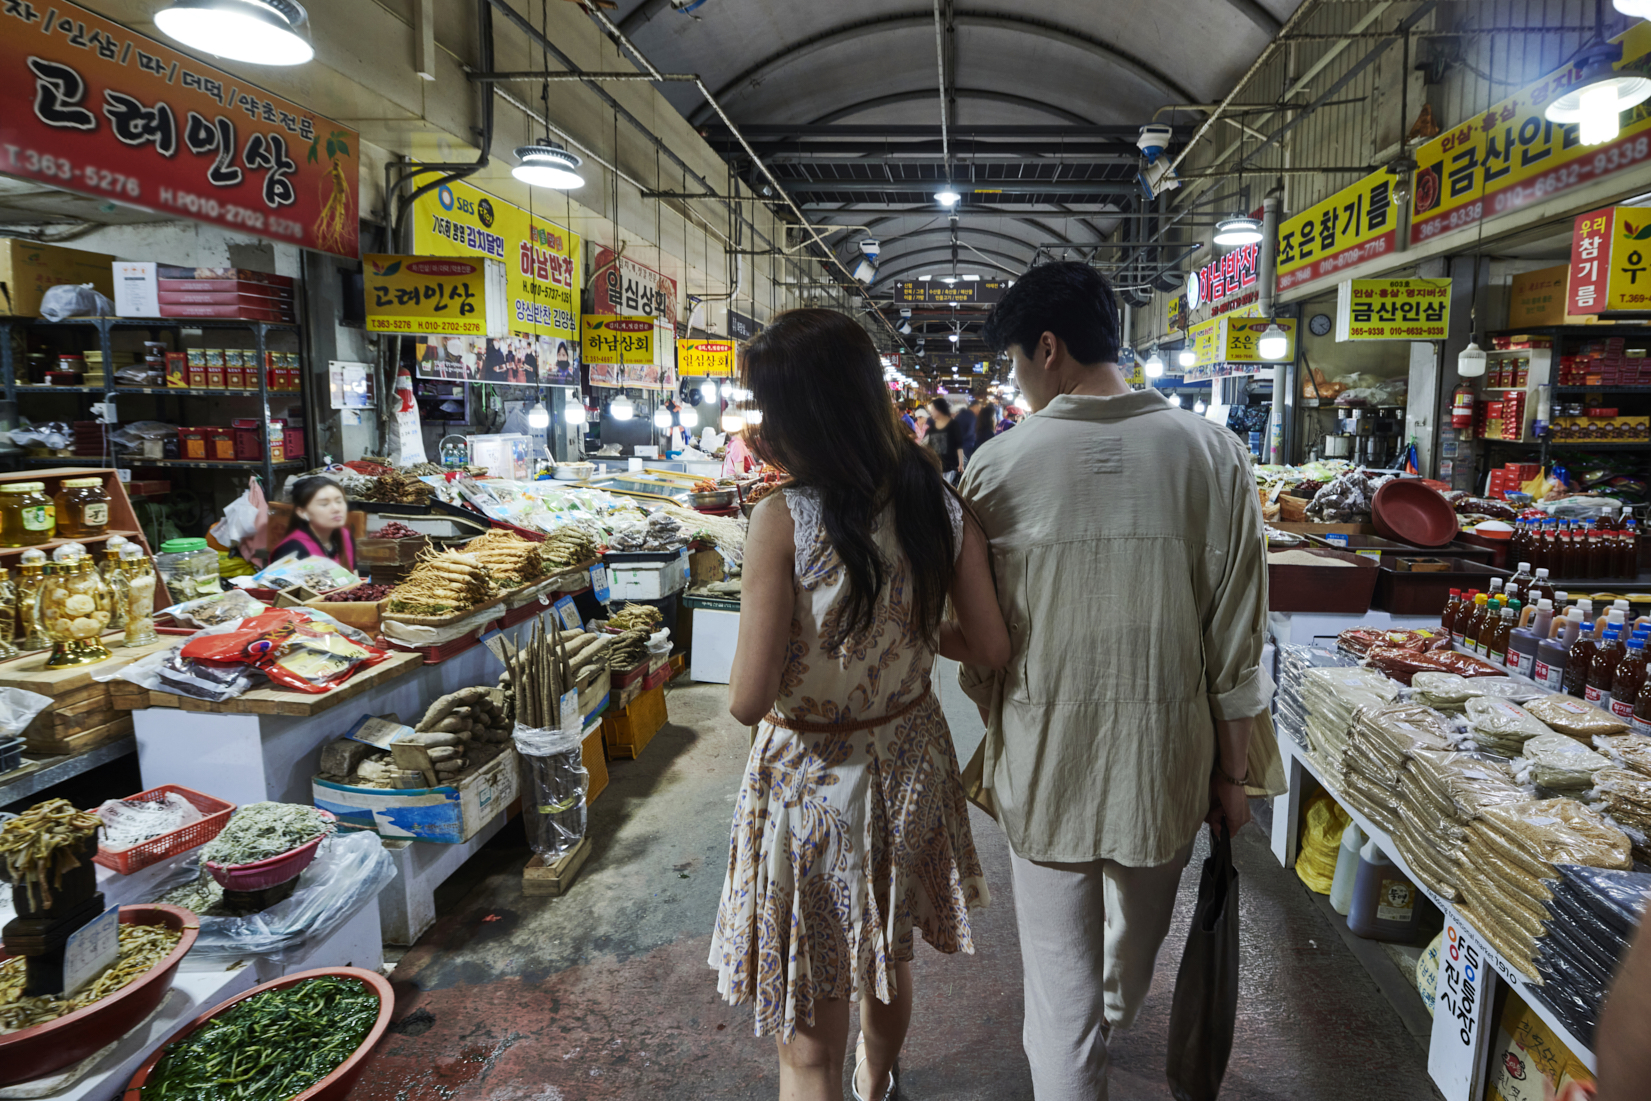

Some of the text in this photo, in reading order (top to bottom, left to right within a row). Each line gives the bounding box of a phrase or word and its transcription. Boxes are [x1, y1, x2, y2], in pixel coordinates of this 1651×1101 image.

[26, 56, 296, 208] 고려인삼
[1419, 137, 1648, 240] 365-9338 010-6632-9338
[456, 197, 474, 215] SBS
[1280, 179, 1391, 266] 조은참기름
[466, 225, 504, 258] 김치달인
[1579, 216, 1606, 238] 우리
[520, 241, 574, 288] 하남반찬
[1320, 237, 1386, 274] 010-8709-7715
[1575, 236, 1603, 307] 참기름
[1200, 243, 1258, 303] 하남반찬
[373, 282, 476, 316] 고려인삼
[606, 270, 667, 319] 일심상회
[371, 319, 481, 332] T.363-5276 H.010-2702-5276
[515, 299, 576, 331] 양심반찬 김양심
[1352, 301, 1446, 323] 금산인삼
[588, 334, 648, 353] 하남상회
[1351, 326, 1445, 336] 365-9338 010-6632-9338
[1494, 957, 1517, 985] 1910
